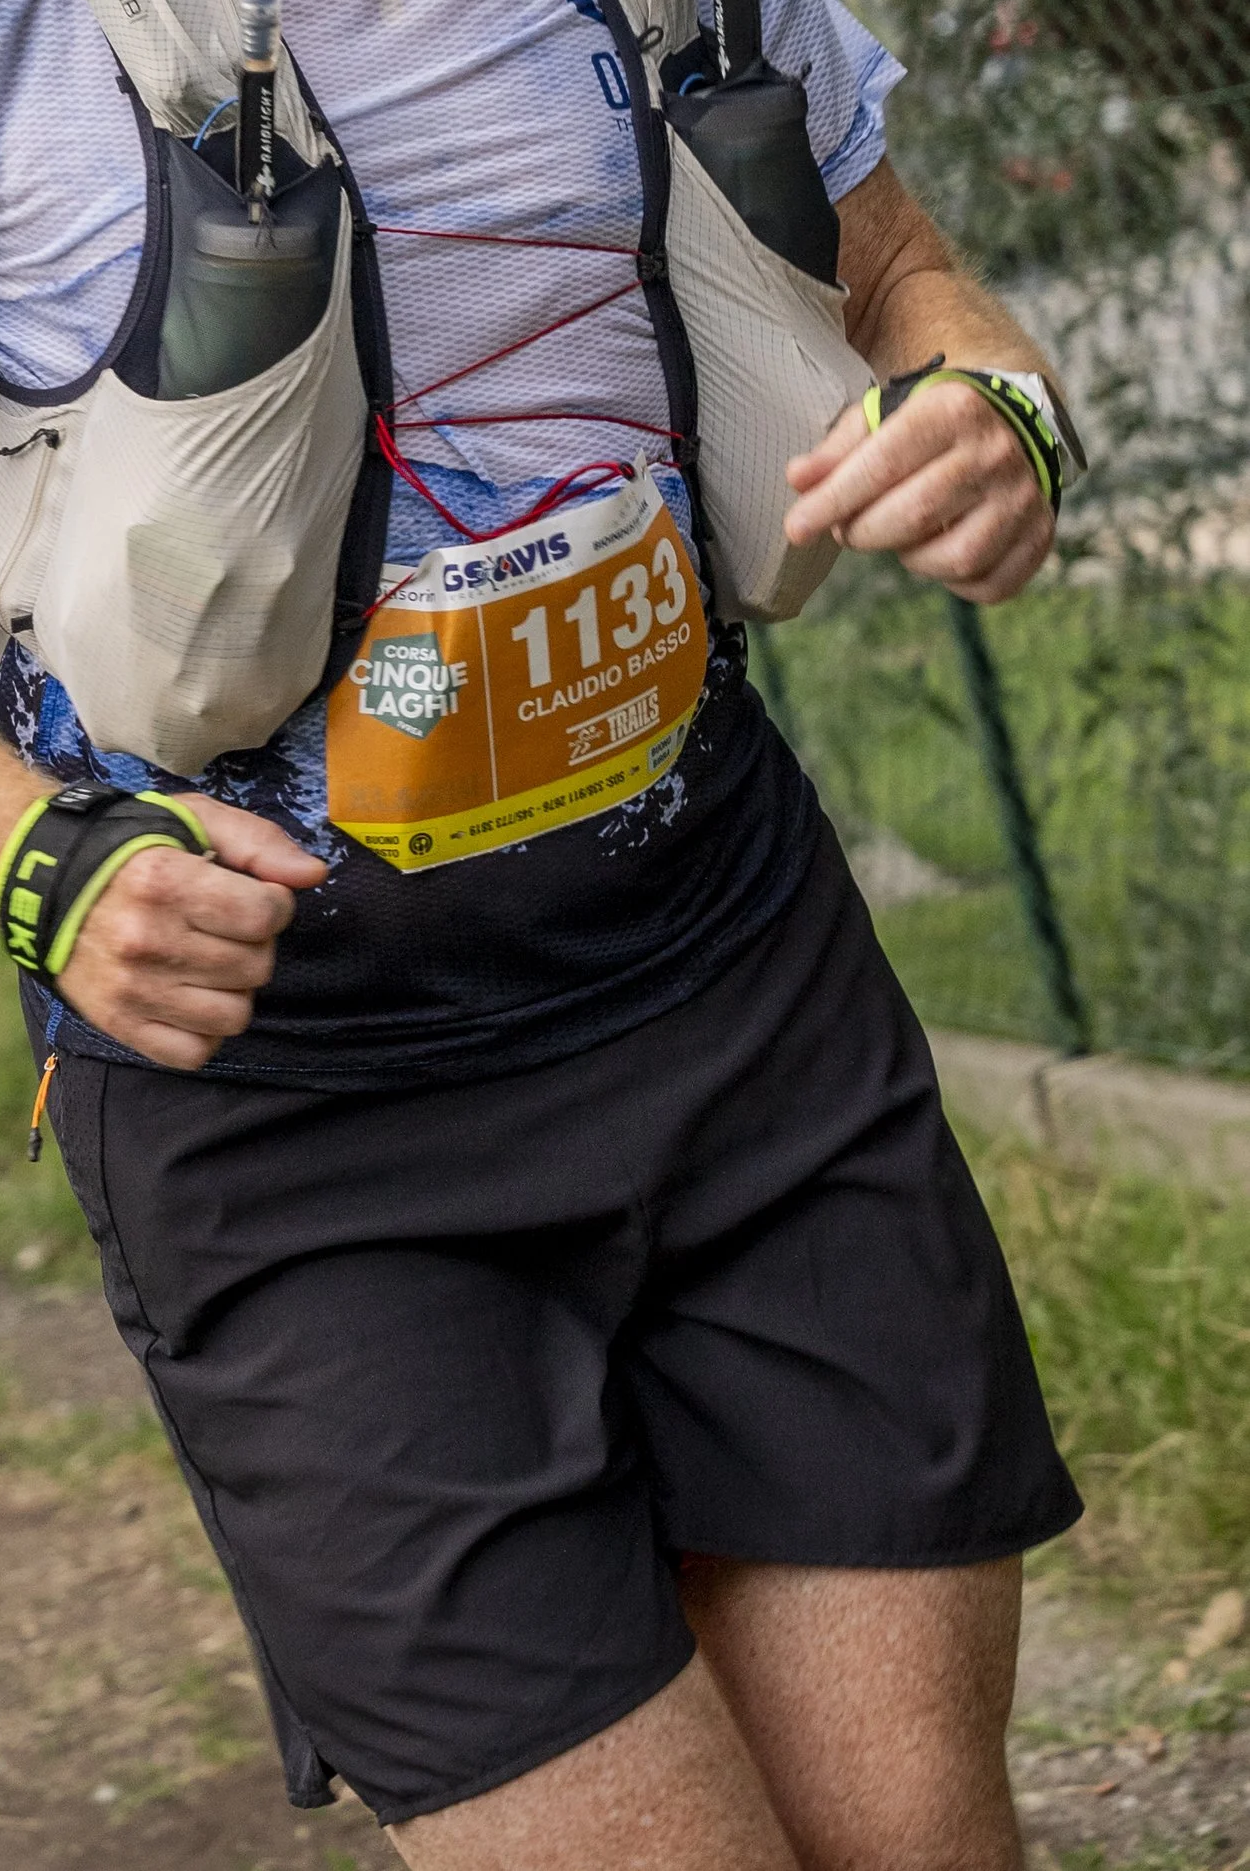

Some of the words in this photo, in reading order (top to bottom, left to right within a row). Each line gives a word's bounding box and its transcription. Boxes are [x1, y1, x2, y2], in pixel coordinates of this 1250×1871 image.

[260, 87, 273, 163] RAIDLIGHT
[511, 537, 687, 689] 1133
[348, 658, 469, 692] CINQUE
[384, 645, 438, 662] CORSA
[518, 665, 623, 722] CLAUDIO
[627, 622, 691, 678] BASSO
[358, 688, 459, 719] LAGHI
[607, 692, 660, 742] TRAILS
